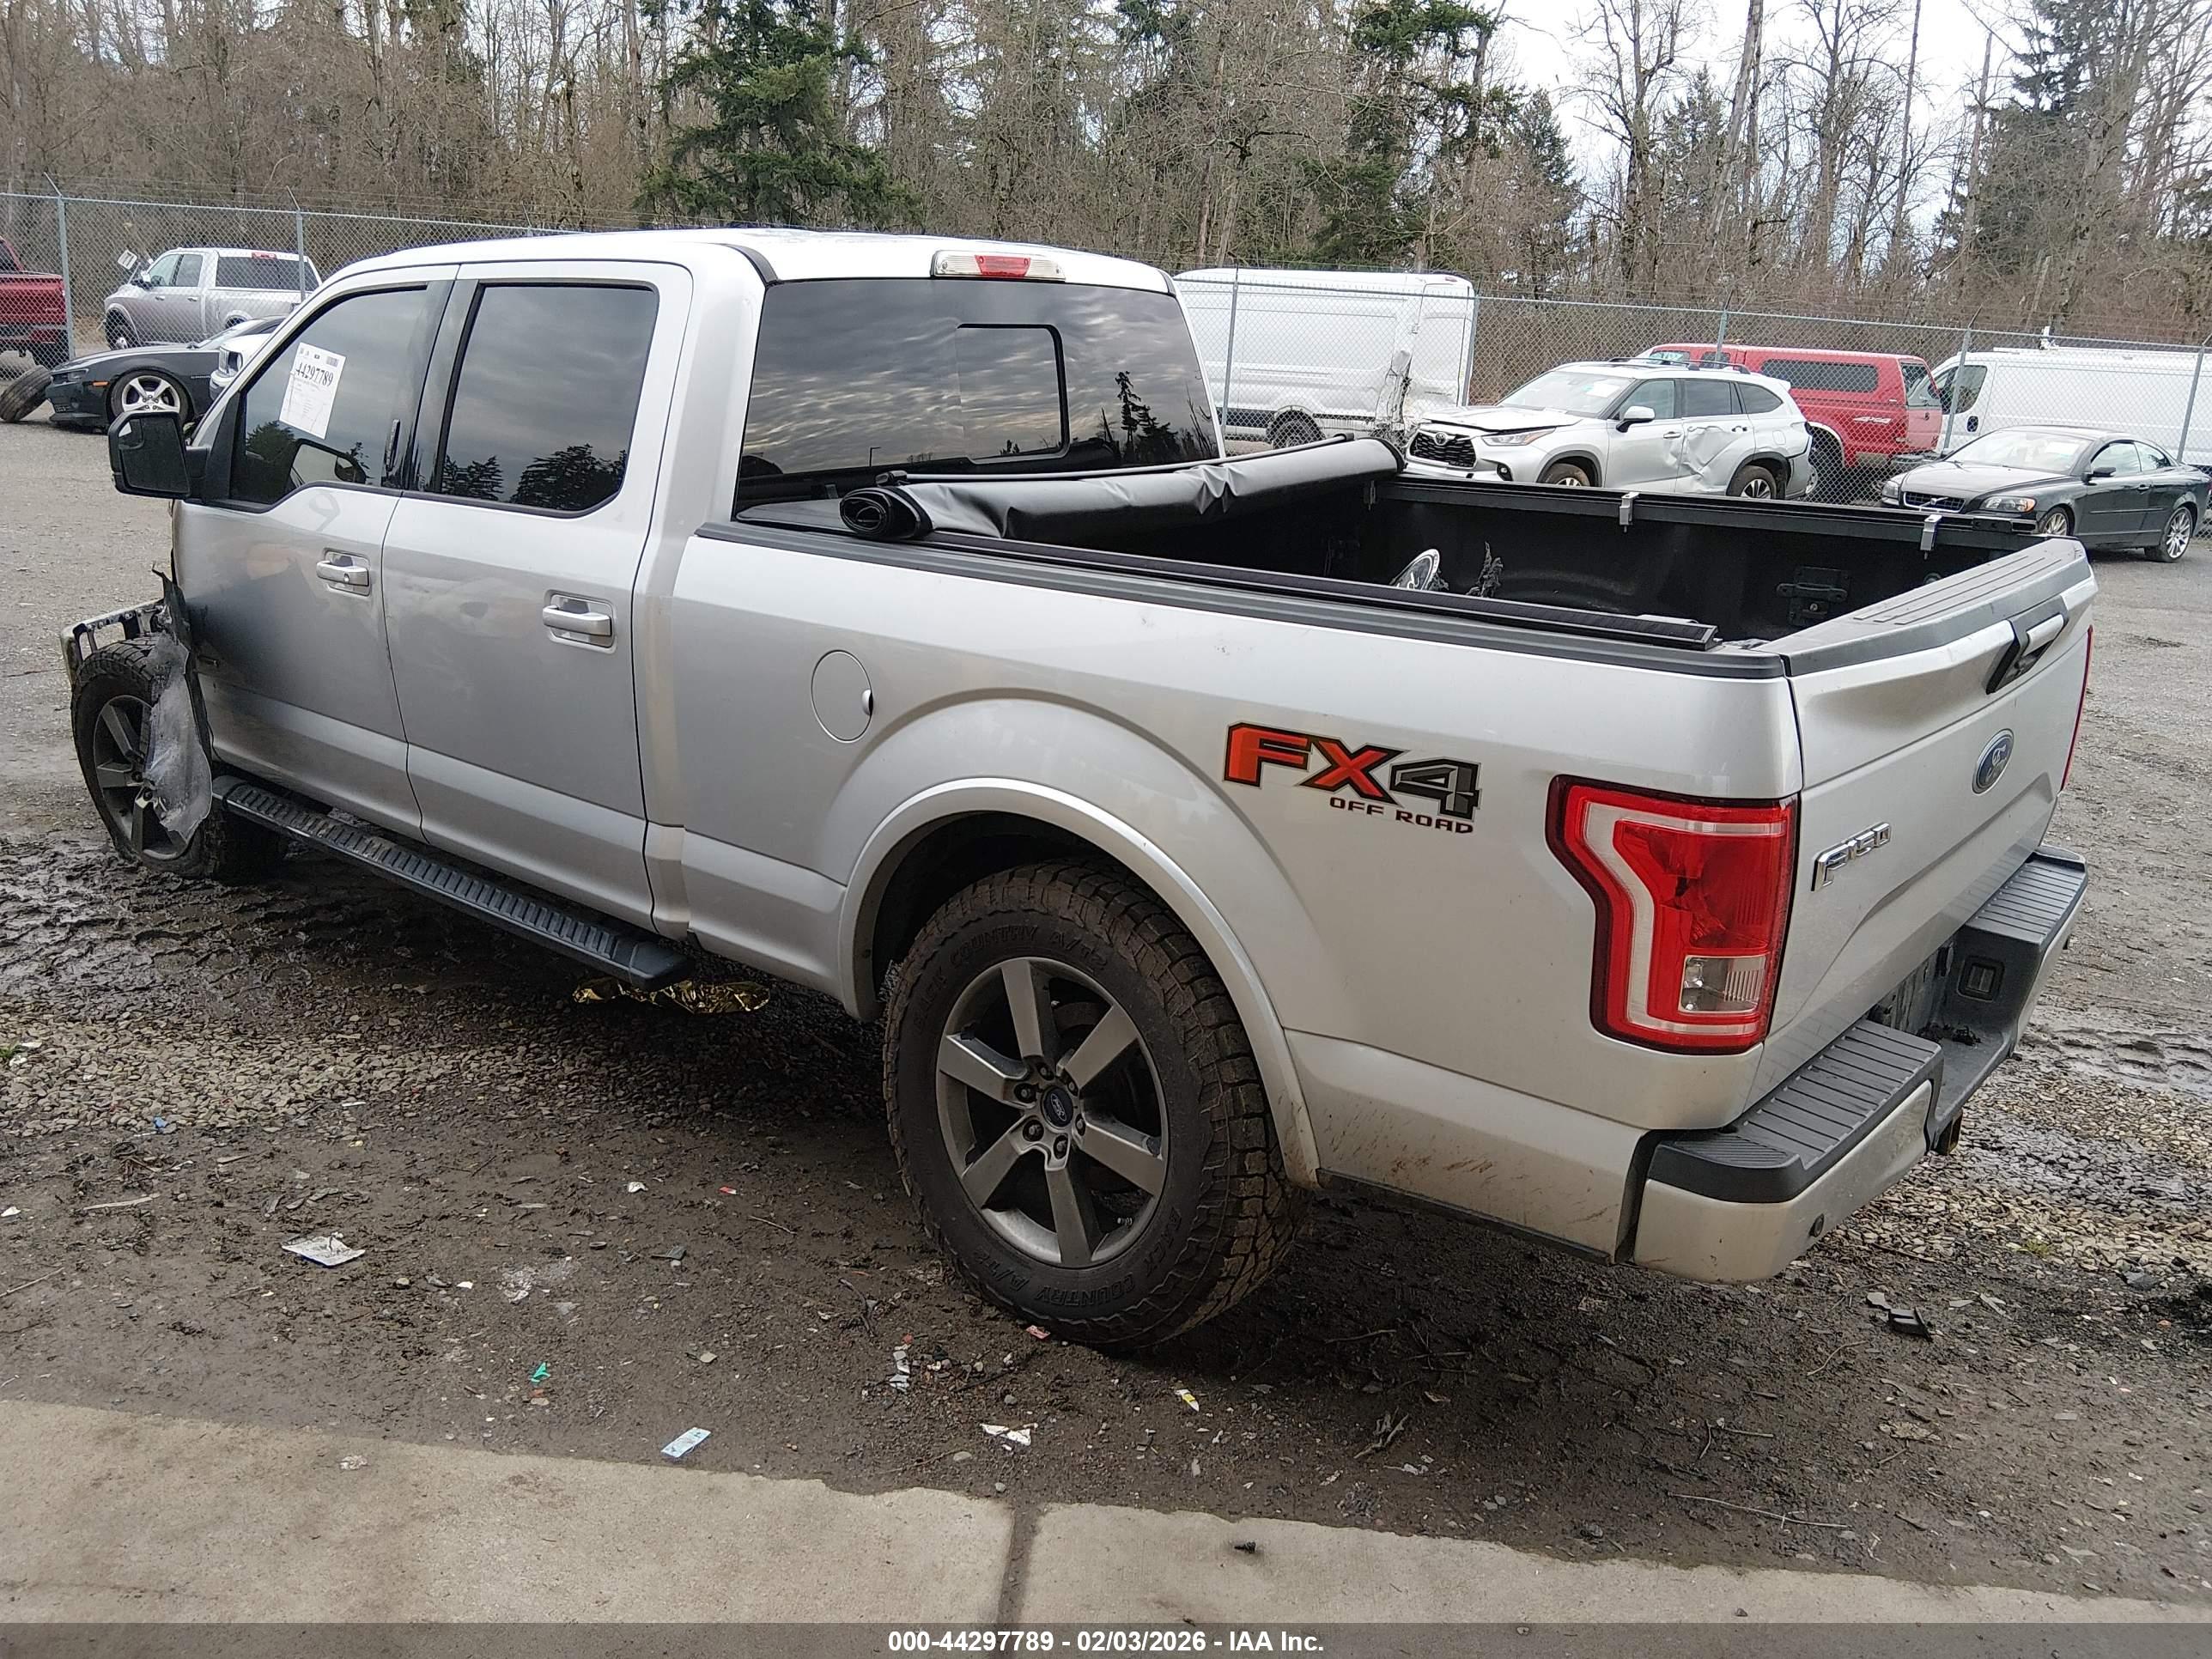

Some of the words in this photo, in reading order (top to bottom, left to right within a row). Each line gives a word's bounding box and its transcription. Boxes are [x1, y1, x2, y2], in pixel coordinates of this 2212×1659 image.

[295, 362, 334, 387] 44297789
[1224, 721, 1482, 822] FX4
[1329, 796, 1384, 816] OFF
[1395, 810, 1474, 835] ROAD
[949, 924, 1038, 968] COUNTRY
[1036, 1271, 1136, 1307] COUNTRY
